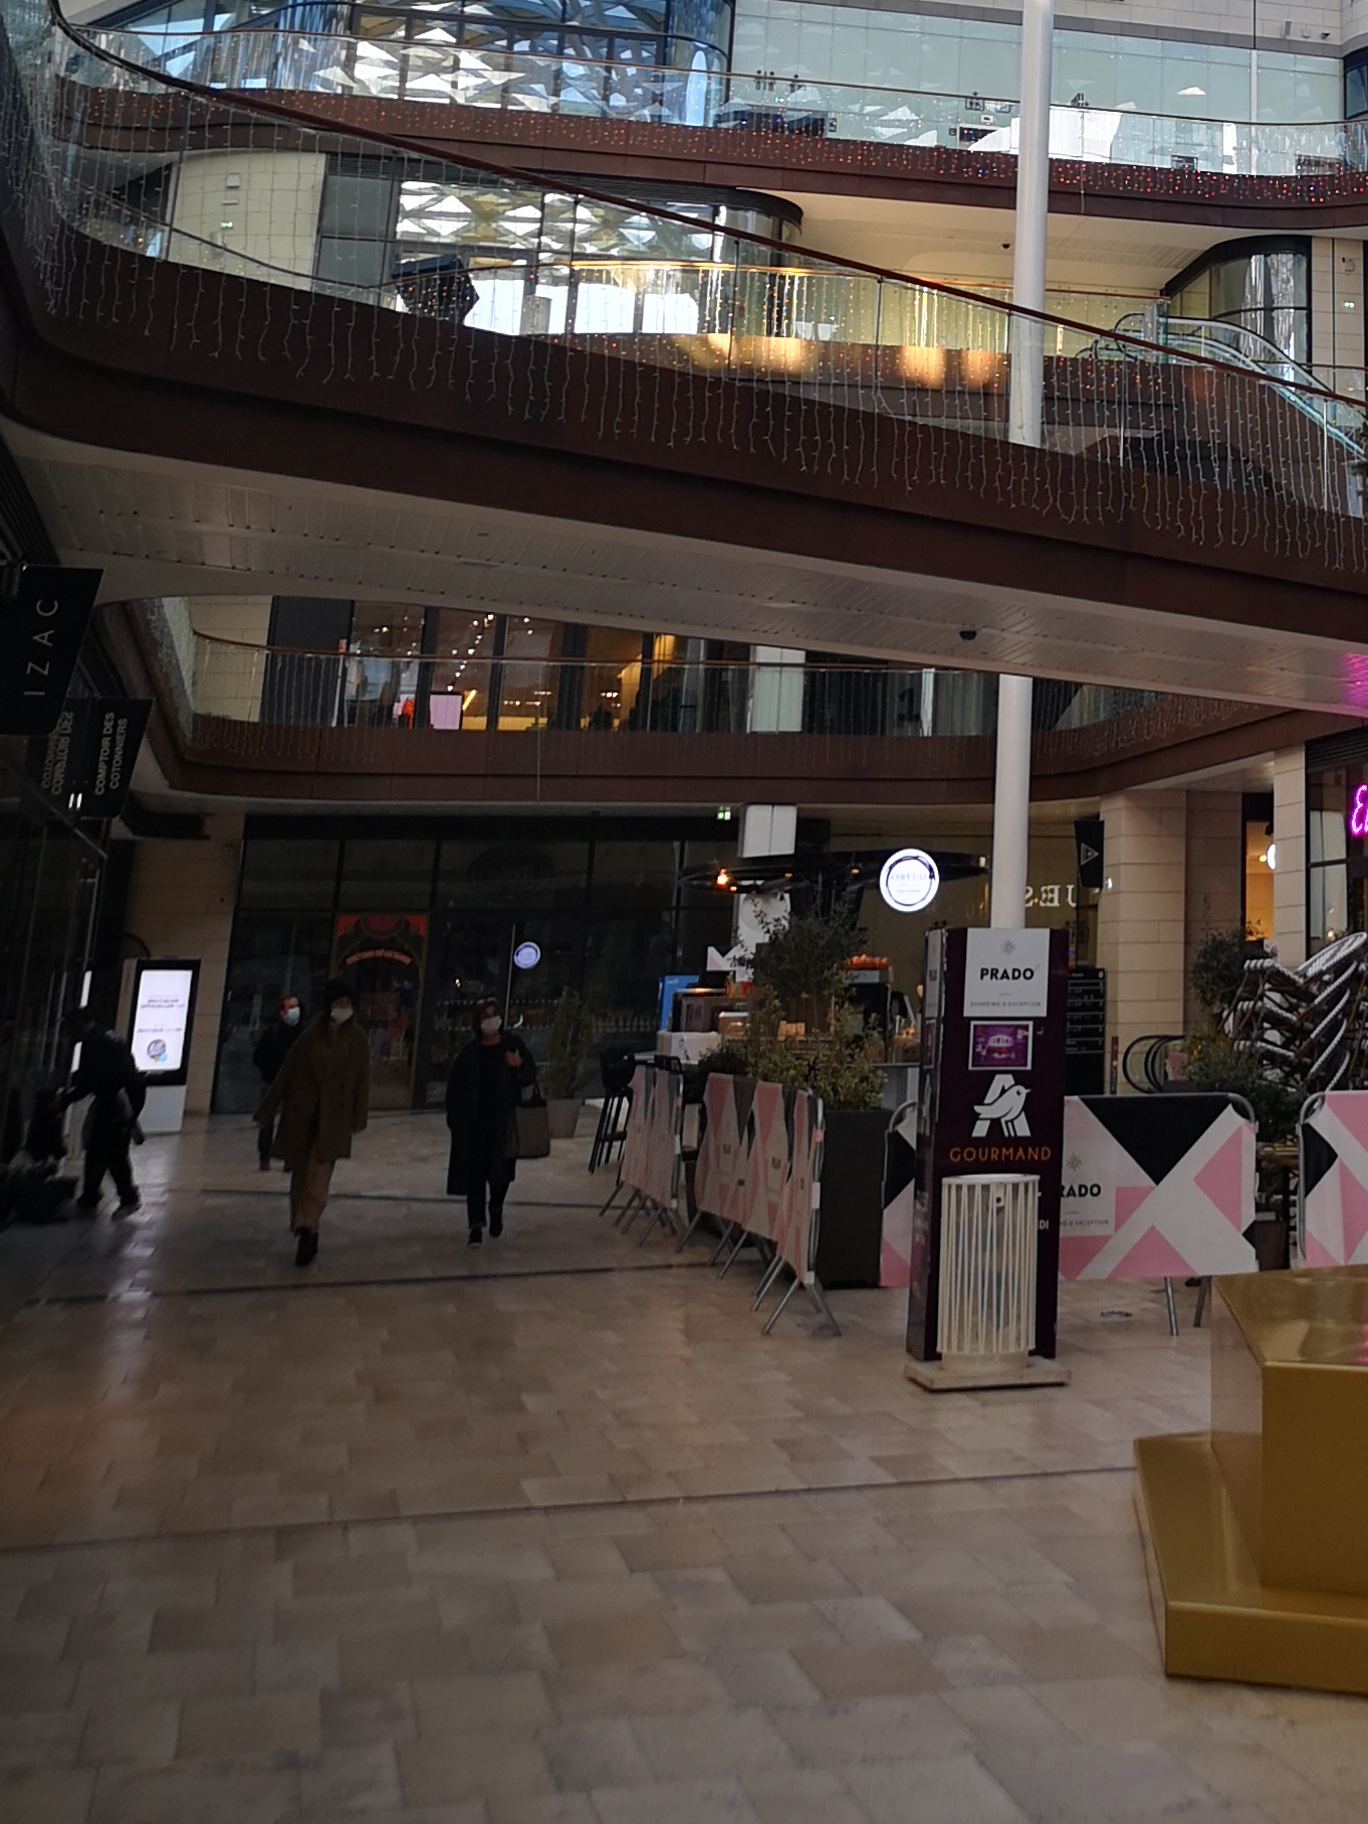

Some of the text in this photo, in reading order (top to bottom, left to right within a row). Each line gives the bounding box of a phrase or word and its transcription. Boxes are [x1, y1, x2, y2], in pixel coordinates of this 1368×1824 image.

[23, 599, 59, 696] IZAC
[94, 711, 116, 795] COMPTOIR DES
[109, 717, 129, 790] COTONNIERS
[980, 968, 1034, 981] PRADO
[949, 1146, 1052, 1163] GOURMAND
[1059, 1184, 1101, 1198] RADO
